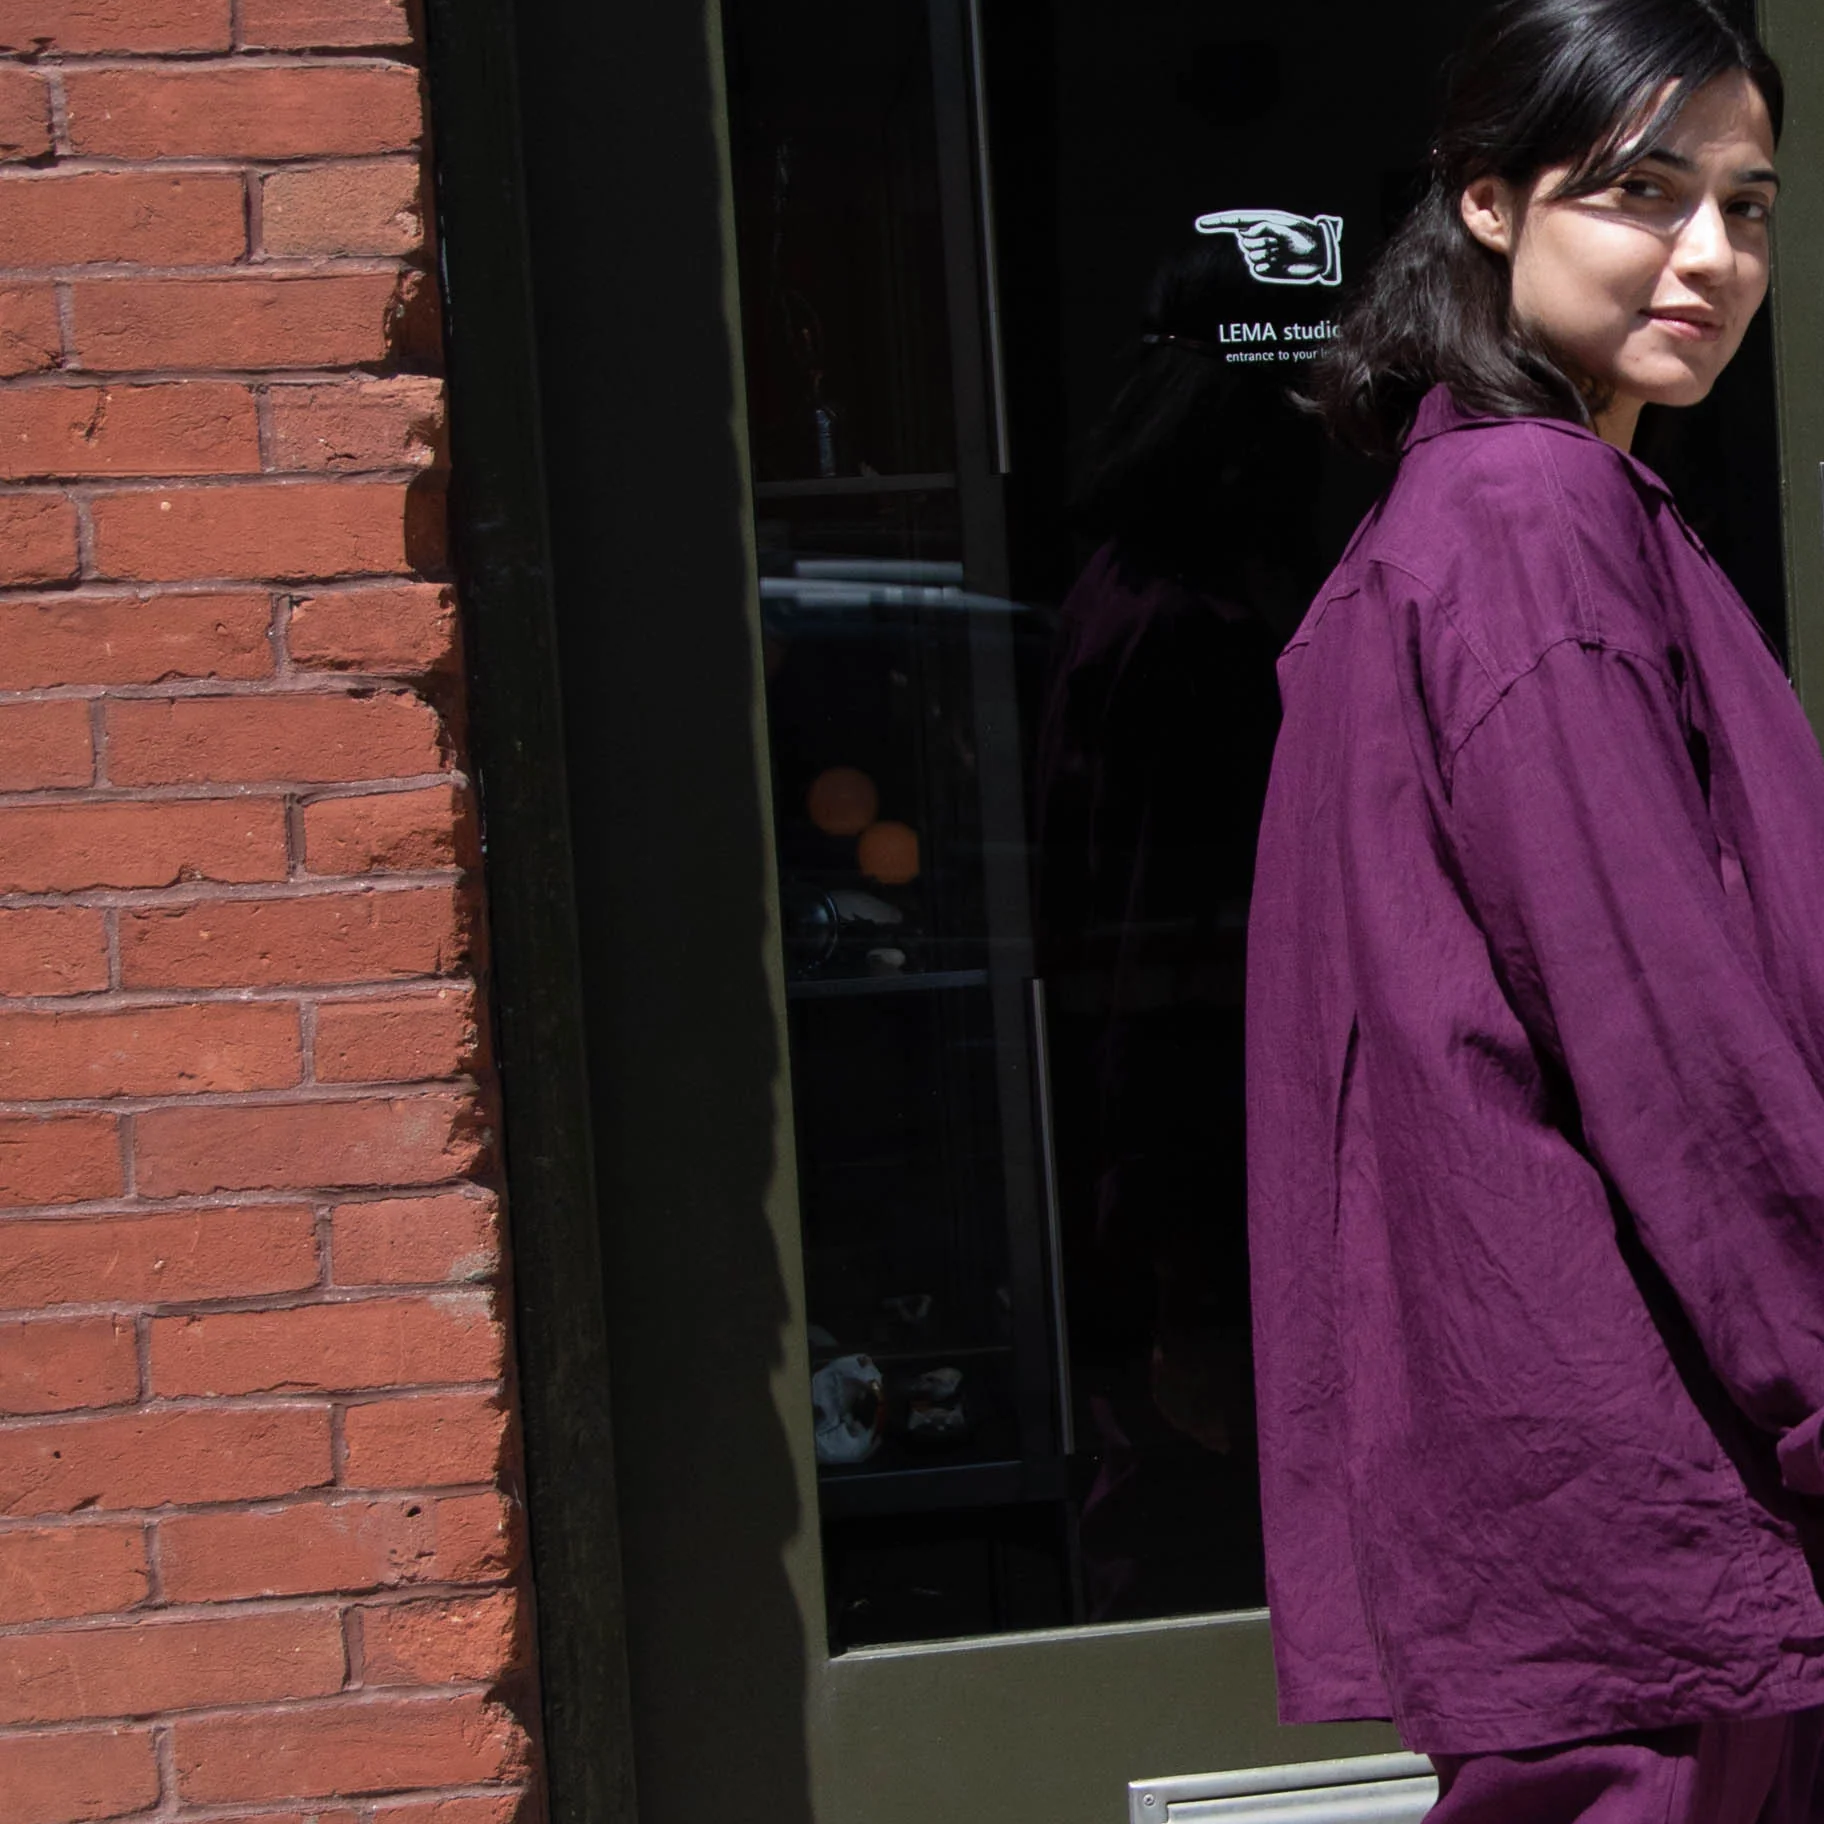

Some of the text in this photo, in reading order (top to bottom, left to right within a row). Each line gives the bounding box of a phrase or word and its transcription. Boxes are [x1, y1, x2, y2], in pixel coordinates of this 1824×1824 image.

[1219, 322, 1278, 343] LEMA
[1226, 350, 1274, 363] entrance
[1278, 350, 1290, 361] to
[1292, 349, 1318, 363] your
